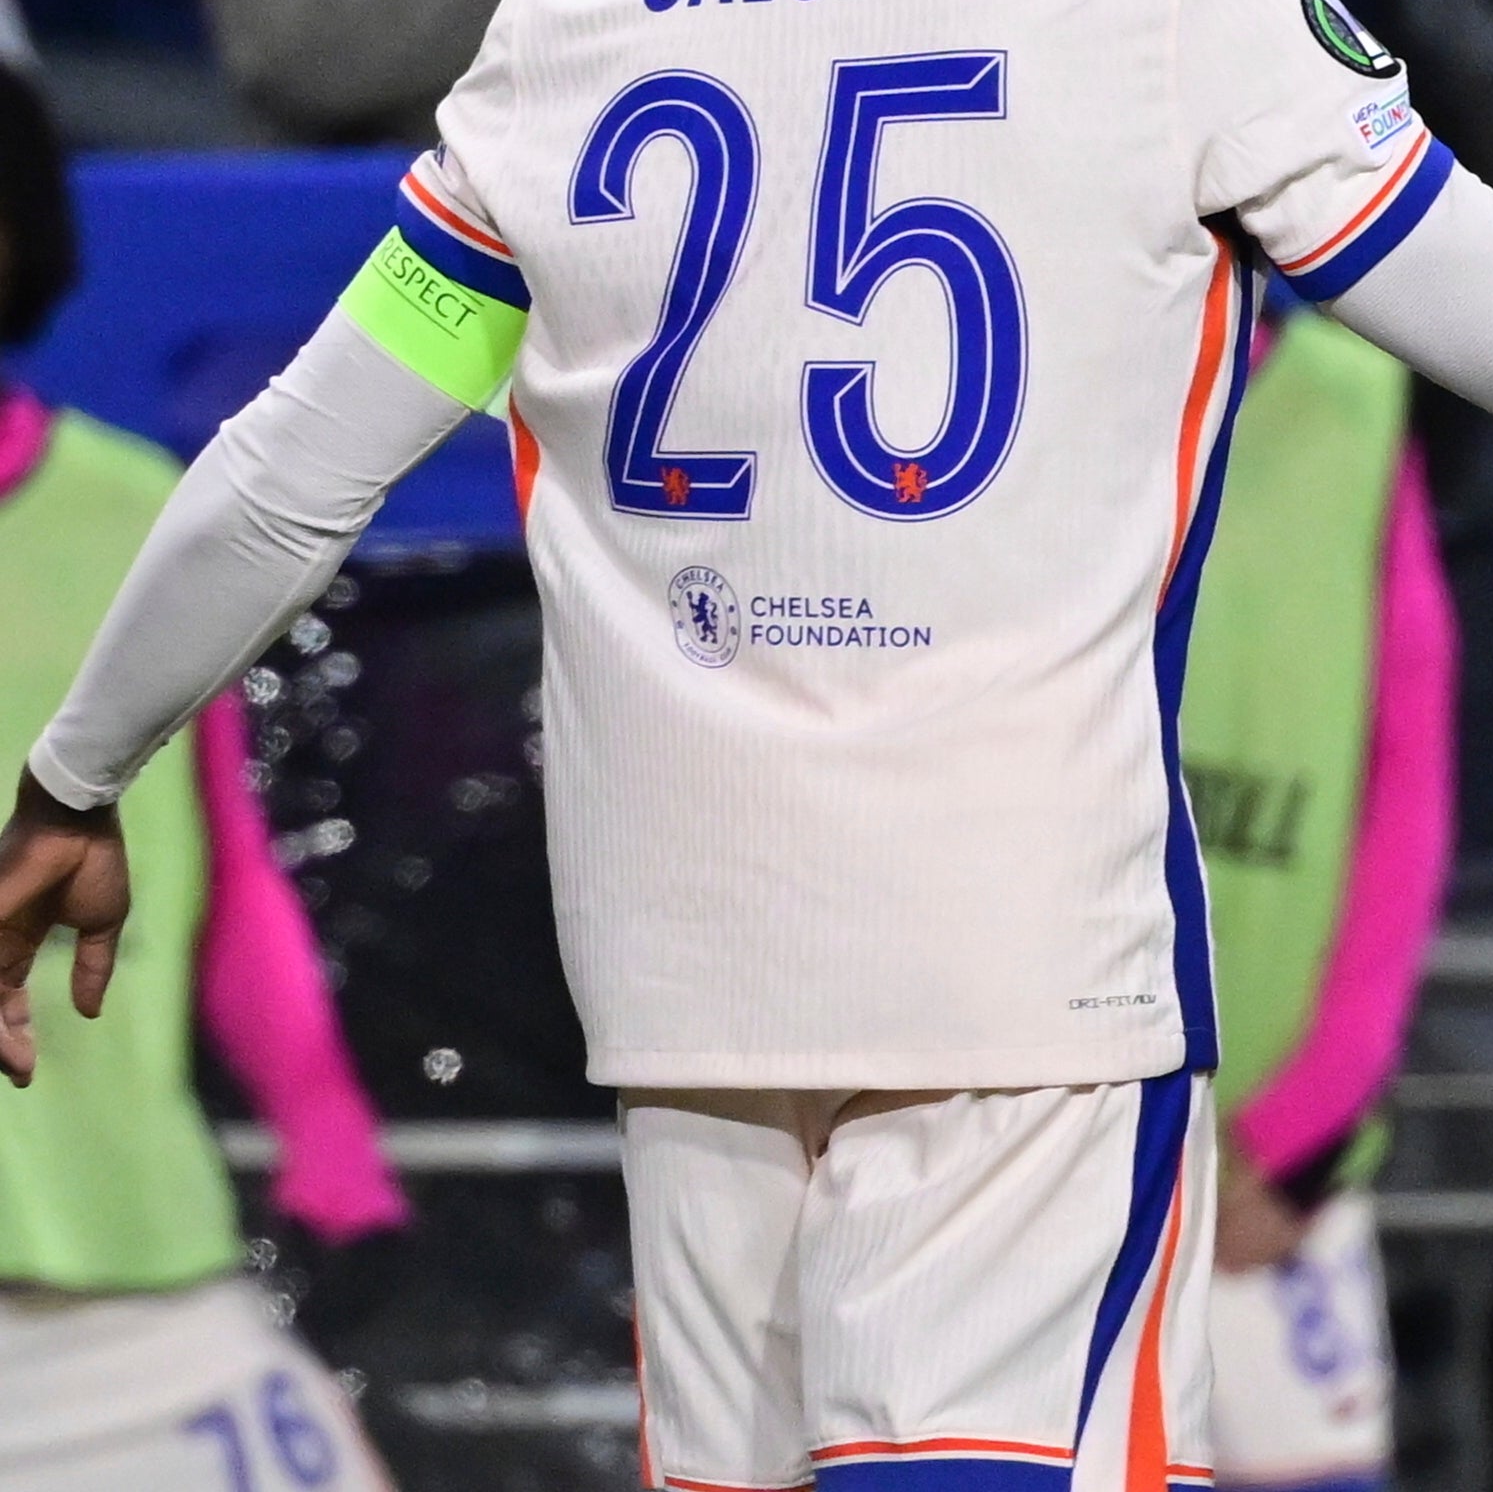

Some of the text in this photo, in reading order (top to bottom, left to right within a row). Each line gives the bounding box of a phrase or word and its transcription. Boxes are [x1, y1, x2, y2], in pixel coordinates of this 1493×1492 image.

[379, 238, 478, 328] RESPECT
[568, 49, 1029, 522] 25
[750, 596, 874, 620] CHELSEA
[750, 624, 932, 648] FOUNDATION
